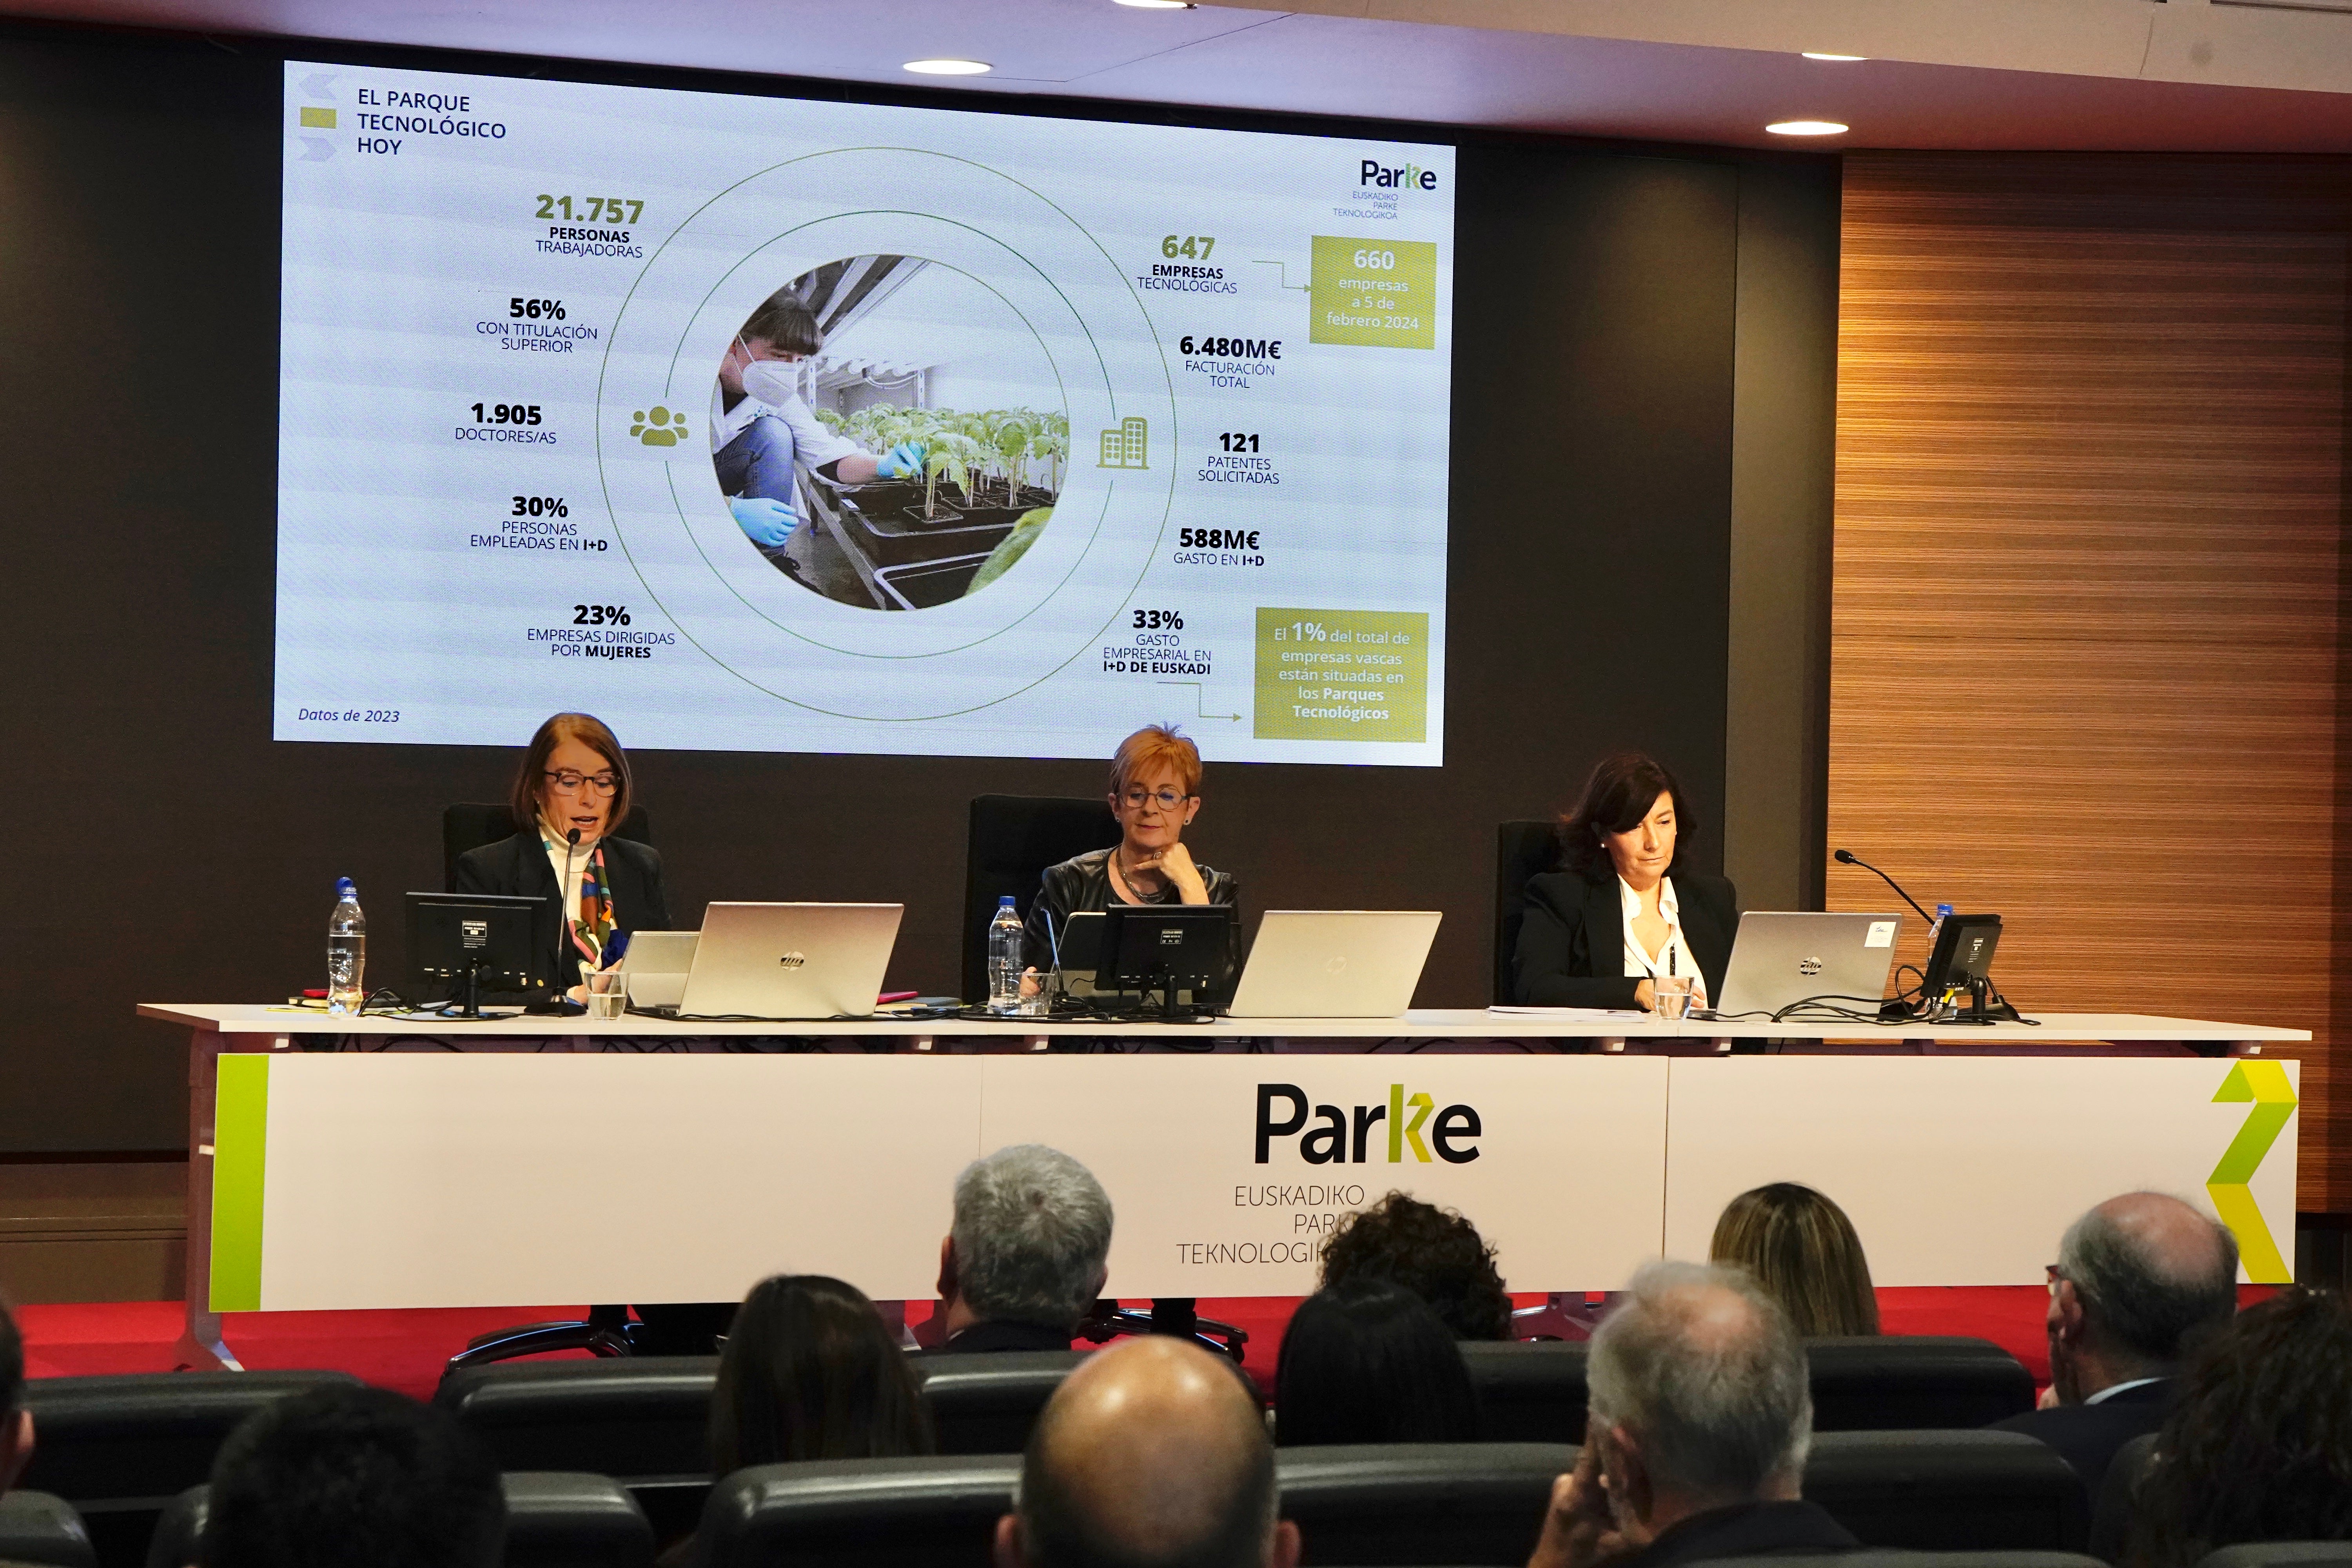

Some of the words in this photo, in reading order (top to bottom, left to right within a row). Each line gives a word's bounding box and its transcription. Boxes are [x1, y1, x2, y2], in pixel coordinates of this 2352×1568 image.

[359, 89, 381, 105] EL
[387, 91, 470, 113] PARQUE
[358, 113, 506, 138] TECNOLÓGICO
[358, 138, 402, 155] HOY
[1361, 160, 1436, 190] Parke
[1353, 191, 1398, 201] EUSKADIKO
[535, 194, 644, 224] 21.757
[1374, 202, 1397, 210] PARKE
[550, 227, 630, 243] PERSONAS
[536, 240, 642, 258] TRABAJADORAS
[1161, 235, 1215, 260] 647
[1354, 250, 1395, 270] 660
[1152, 264, 1223, 279] EMPRESAS
[1138, 274, 1237, 294] TECNOLÓGICAS
[1339, 278, 1409, 294] empresas
[510, 298, 566, 320] 56%
[1352, 298, 1360, 309] a
[1365, 296, 1373, 309] 5
[1377, 296, 1395, 310] de
[1327, 312, 1381, 328] febrero
[1386, 316, 1419, 330] 2024
[477, 322, 509, 336] CON
[513, 321, 598, 339] TITULACIÓN
[502, 338, 572, 353] SUPERIOR
[1180, 336, 1282, 359] 6.480M€
[1185, 361, 1275, 376] FACTURACIÓN
[1210, 376, 1250, 388] TOTAL
[471, 403, 542, 425] 1.905
[456, 428, 557, 444] DOCTORES/AS
[1219, 433, 1259, 453] 121
[1208, 457, 1271, 470] PATENTES
[1198, 470, 1279, 484] SOLICITADAS
[512, 496, 568, 518] 30%
[502, 521, 577, 536] PERSONAS
[471, 535, 555, 550] EMPLEADAS
[560, 537, 579, 550] EN
[583, 539, 608, 552] I+D
[1180, 528, 1260, 550] 588M€
[1174, 553, 1217, 565] GASTO
[1222, 554, 1238, 566] EN
[1242, 555, 1264, 566] I+D
[573, 605, 631, 626] 23%
[1133, 610, 1183, 629] 33%
[528, 629, 601, 643] EMPRESAS
[606, 630, 675, 645] DIRIGIDAS
[1136, 634, 1179, 646] GASTO
[1275, 628, 1287, 641] El
[1292, 622, 1326, 642] 1%
[1330, 630, 1352, 642] del
[1357, 630, 1388, 643] total
[1392, 631, 1410, 644] de
[552, 644, 581, 657] POR
[585, 645, 651, 660] MUJERES
[1104, 648, 1190, 661] EMPRESARIAL
[1195, 650, 1211, 661] EN
[1281, 651, 1351, 667] empresas
[1356, 653, 1402, 664] vascas
[1104, 661, 1126, 672] I+D
[1130, 661, 1147, 673] DE
[1152, 662, 1210, 674] EUSKADI
[1279, 668, 1318, 681] están
[1323, 669, 1381, 683] situadas
[1387, 673, 1404, 683] en
[1299, 686, 1318, 699] los
[1323, 687, 1384, 704] Parques
[299, 708, 339, 721] Datos
[344, 709, 361, 722] de
[365, 710, 400, 722] 2023
[1292, 705, 1388, 722] Tecnológicos
[1255, 1084, 1481, 1164] Parke
[1235, 1185, 1364, 1206] EUSKADIKO
[1295, 1214, 1359, 1234] PARK
